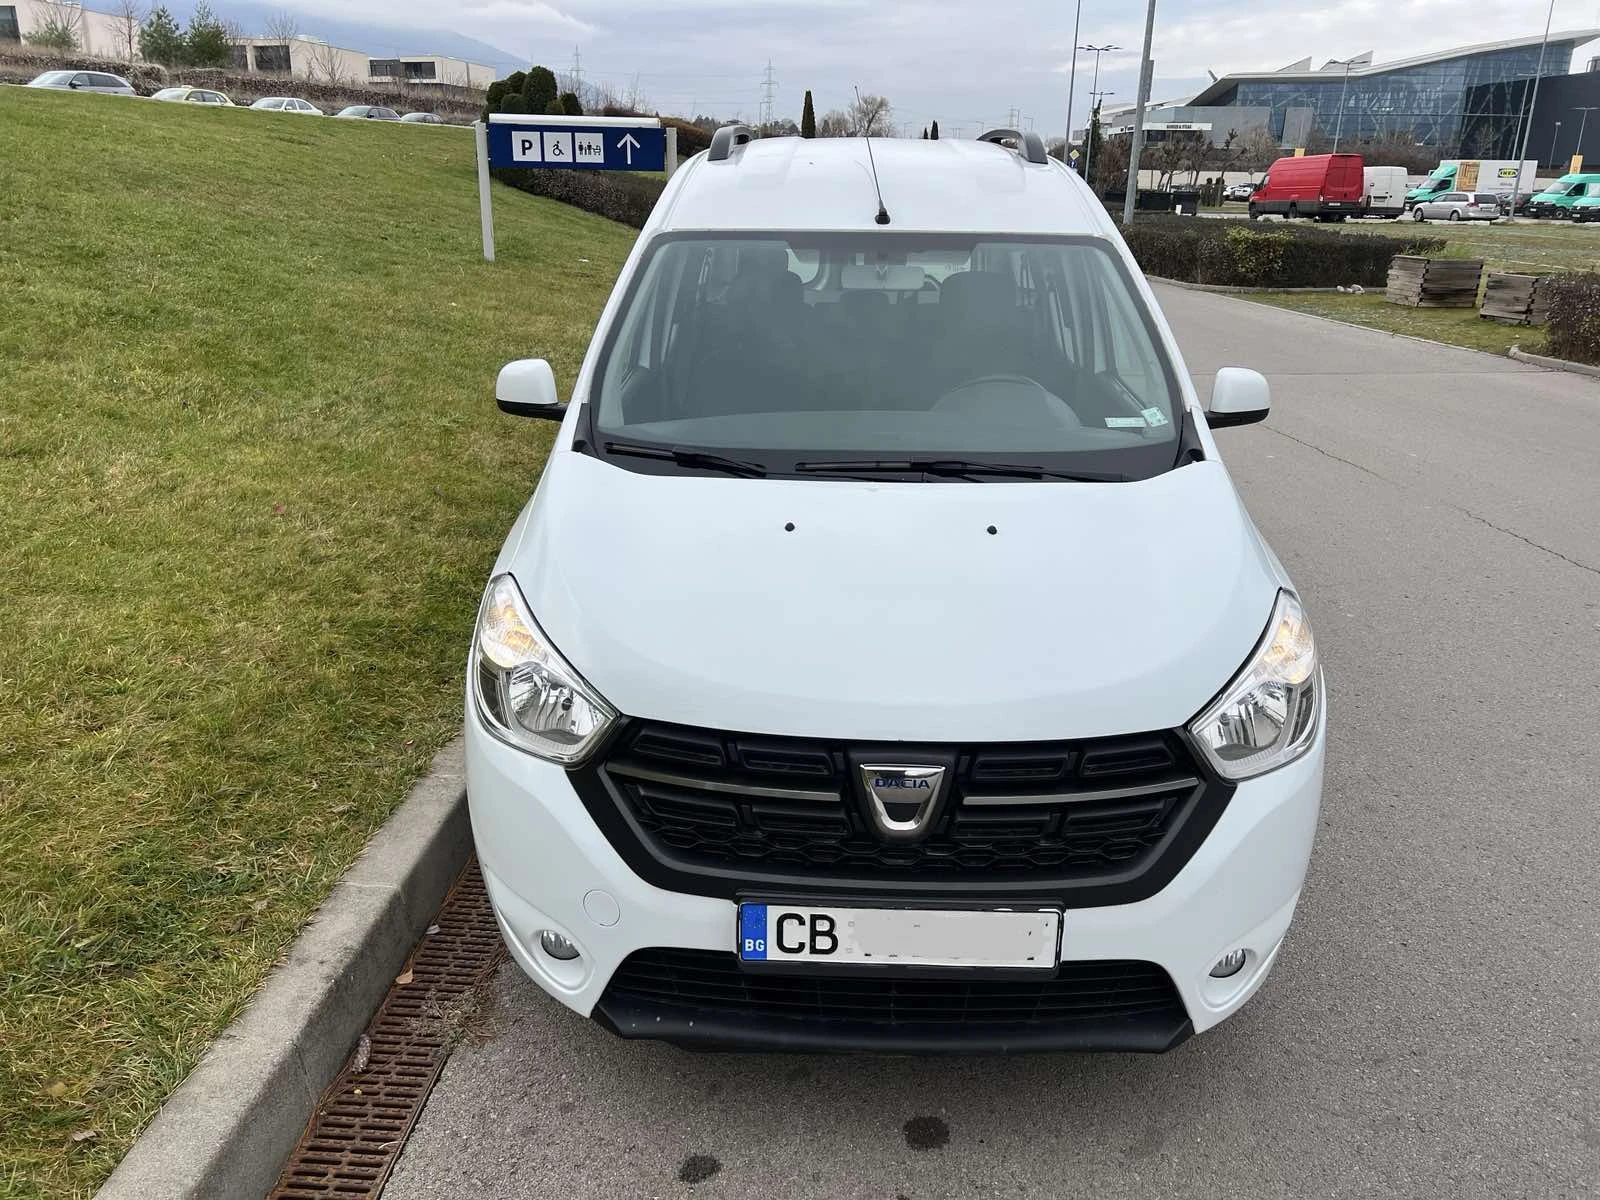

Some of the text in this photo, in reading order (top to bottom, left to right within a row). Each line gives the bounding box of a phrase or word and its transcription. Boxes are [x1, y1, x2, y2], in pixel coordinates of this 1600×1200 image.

[521, 139, 533, 156] P
[875, 778, 930, 789] DACIA
[777, 913, 839, 955] CB
[745, 939, 765, 952] BG
